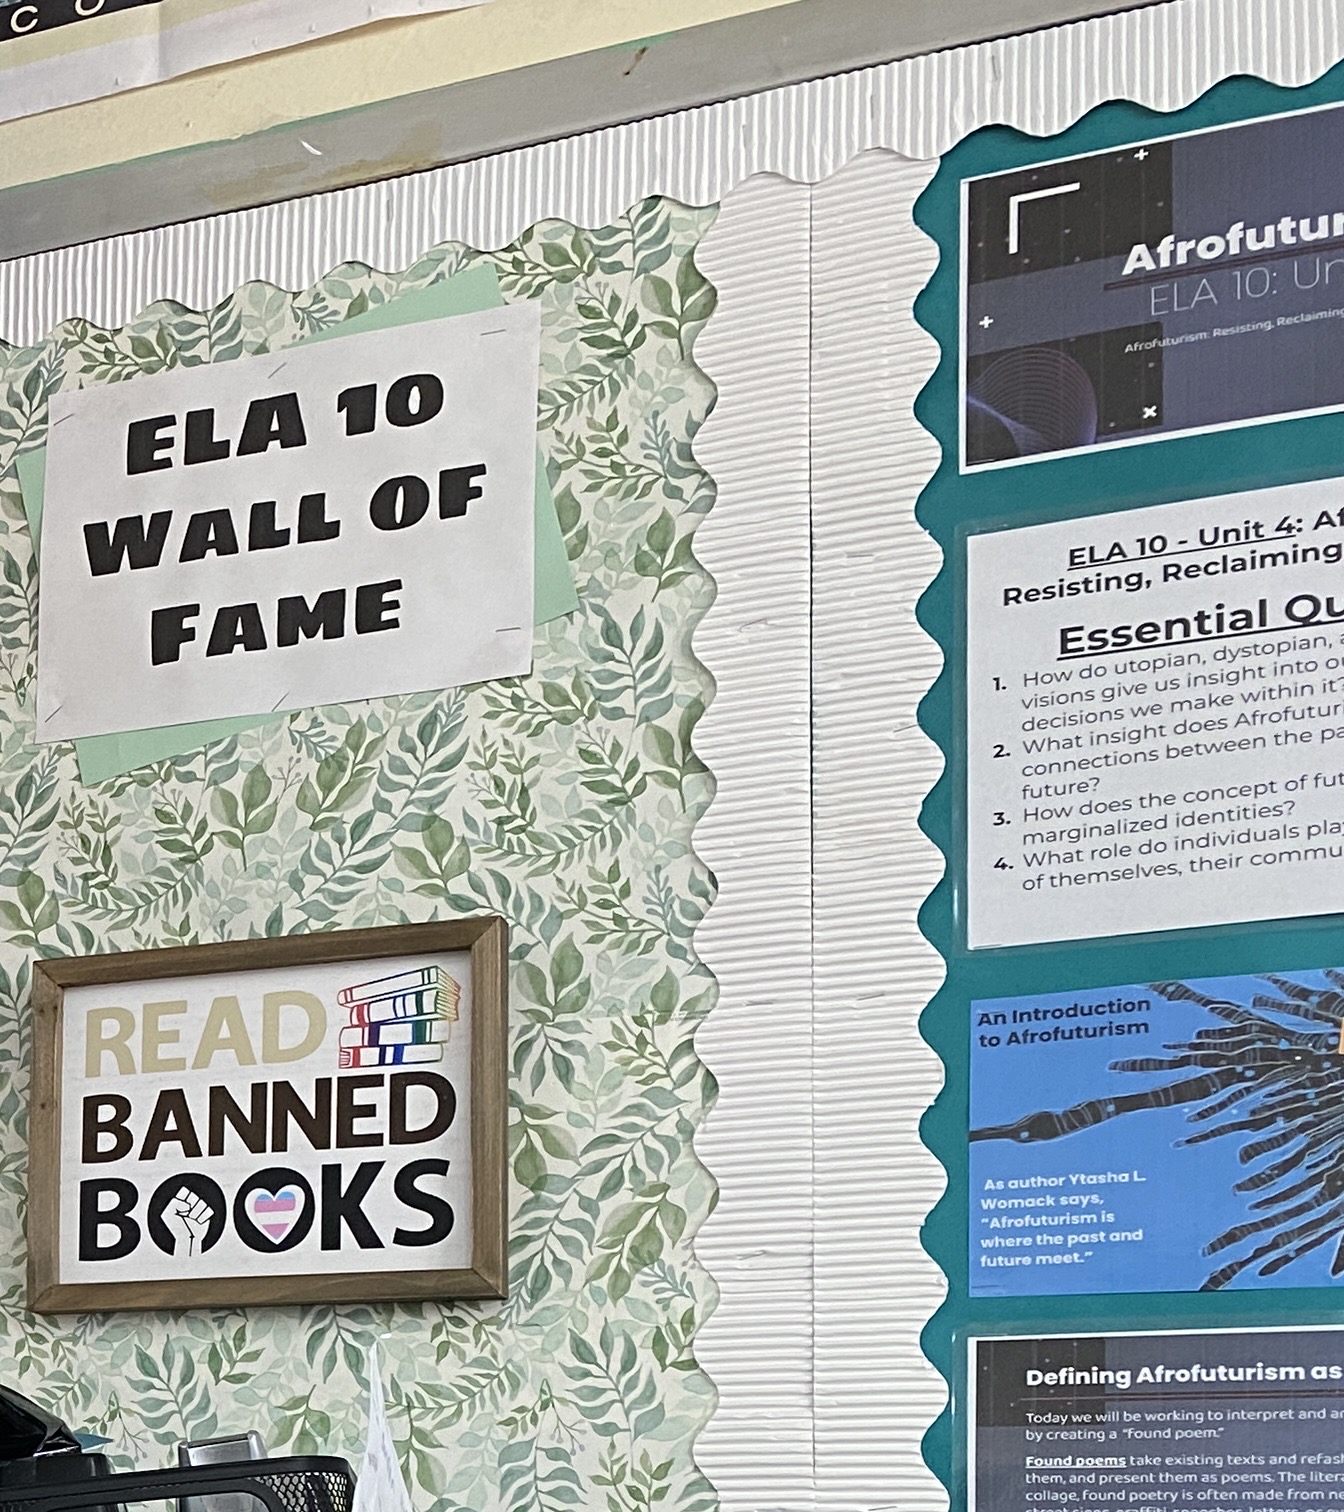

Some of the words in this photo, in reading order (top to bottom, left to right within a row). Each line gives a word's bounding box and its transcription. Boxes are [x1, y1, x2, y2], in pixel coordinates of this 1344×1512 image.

[1151, 278, 1217, 316] ELA
[1233, 268, 1277, 300] 10:
[125, 392, 308, 476] ELA
[336, 373, 445, 435] 10
[83, 492, 341, 578] WALL
[369, 463, 488, 532] OF
[1069, 542, 1127, 568] ELA
[1137, 535, 1167, 557] 10
[1199, 520, 1265, 547] Unit
[1275, 516, 1303, 535] 4:
[1003, 570, 1152, 607] Resisting,
[1162, 542, 1343, 582] Reclaiming
[149, 579, 405, 667] FAME
[1059, 598, 1268, 655] Essential
[1023, 814, 1167, 845] marginalized
[1175, 800, 1296, 828] identities?
[85, 990, 328, 1078] READ
[978, 1011, 1006, 1027] An
[1013, 998, 1151, 1024] Introduction
[979, 1032, 1001, 1047] to
[1006, 1019, 1150, 1045] Afrofuturism
[81, 1071, 458, 1165] BANNED
[78, 1158, 456, 1262] BOOKS
[981, 1195, 1055, 1209] Womack
[1059, 1192, 1104, 1207] says,
[980, 1232, 1033, 1248] where
[1037, 1230, 1063, 1245] the
[1068, 1230, 1105, 1247] past
[1110, 1228, 1144, 1242] and
[1027, 1366, 1131, 1389] Defining
[1136, 1361, 1306, 1383] Afrofuturism
[1311, 1365, 1342, 1380] as
